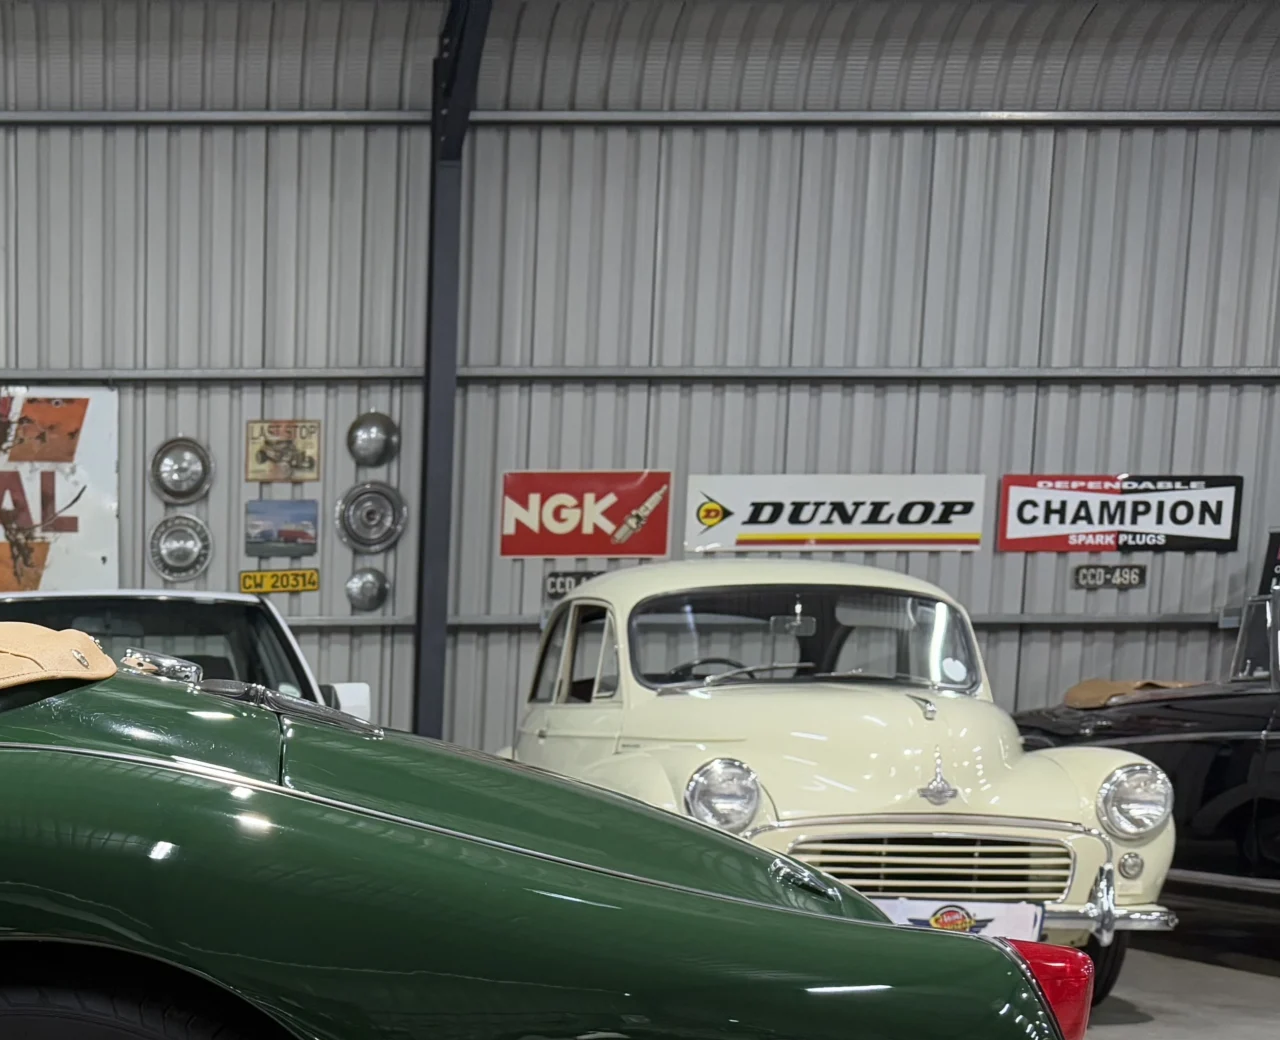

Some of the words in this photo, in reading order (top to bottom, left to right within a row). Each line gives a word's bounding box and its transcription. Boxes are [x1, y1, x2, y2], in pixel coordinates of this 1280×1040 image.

[250, 425, 282, 440] LAST
[284, 425, 318, 440] STOP
[1036, 480, 1205, 490] DEPENDABLE
[502, 492, 618, 535] NGK
[741, 501, 975, 525] DUNLOP
[1016, 499, 1223, 526] CHAMPION
[1067, 534, 1115, 545] SPARK
[1118, 534, 1166, 545] PLUGS
[242, 574, 265, 590] CW
[270, 570, 317, 589] 20314
